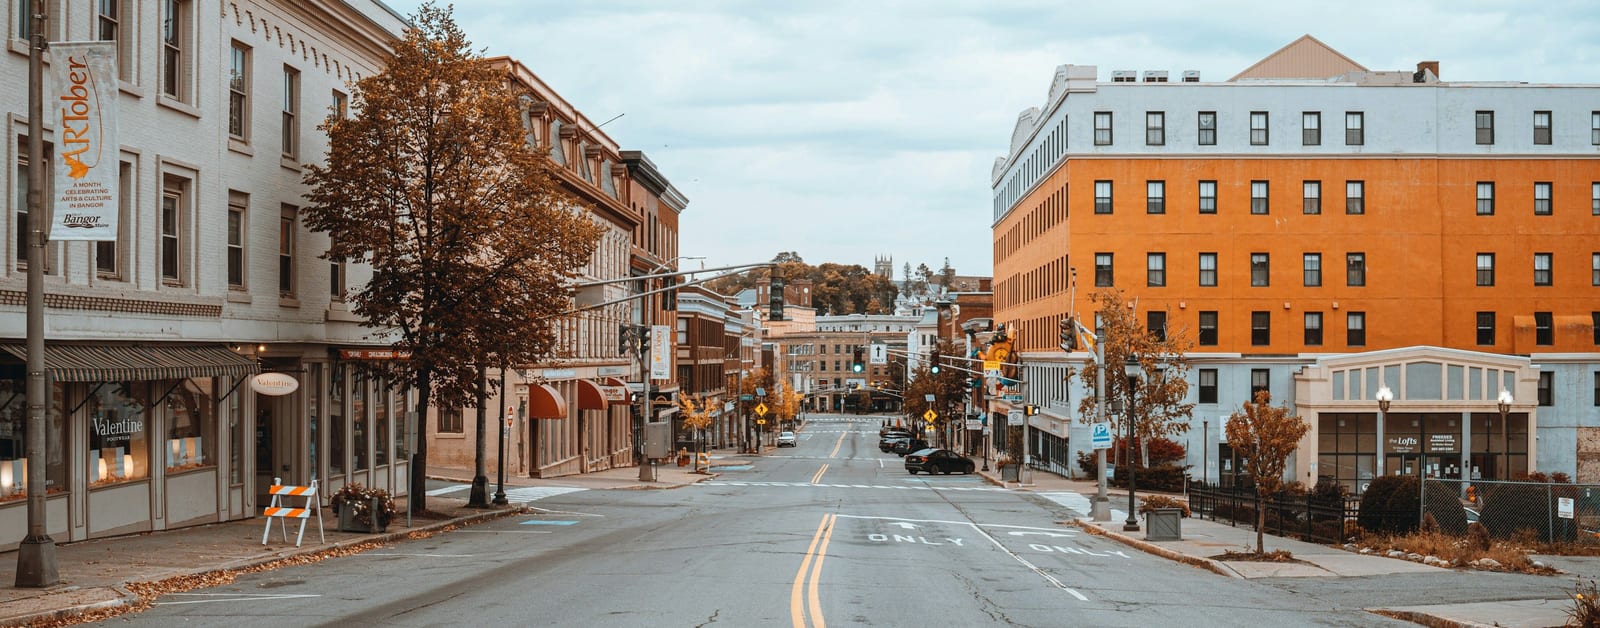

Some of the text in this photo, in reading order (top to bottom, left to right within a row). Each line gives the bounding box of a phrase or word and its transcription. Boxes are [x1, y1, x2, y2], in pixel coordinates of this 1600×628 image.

[60, 56, 90, 164] ARTober
[63, 213, 101, 226] Bangor
[257, 378, 294, 388] Valentine
[93, 417, 143, 436] Valentine
[1397, 437, 1418, 446] Lofts
[867, 533, 965, 547] ONLY
[1027, 543, 1132, 560] ONLY
